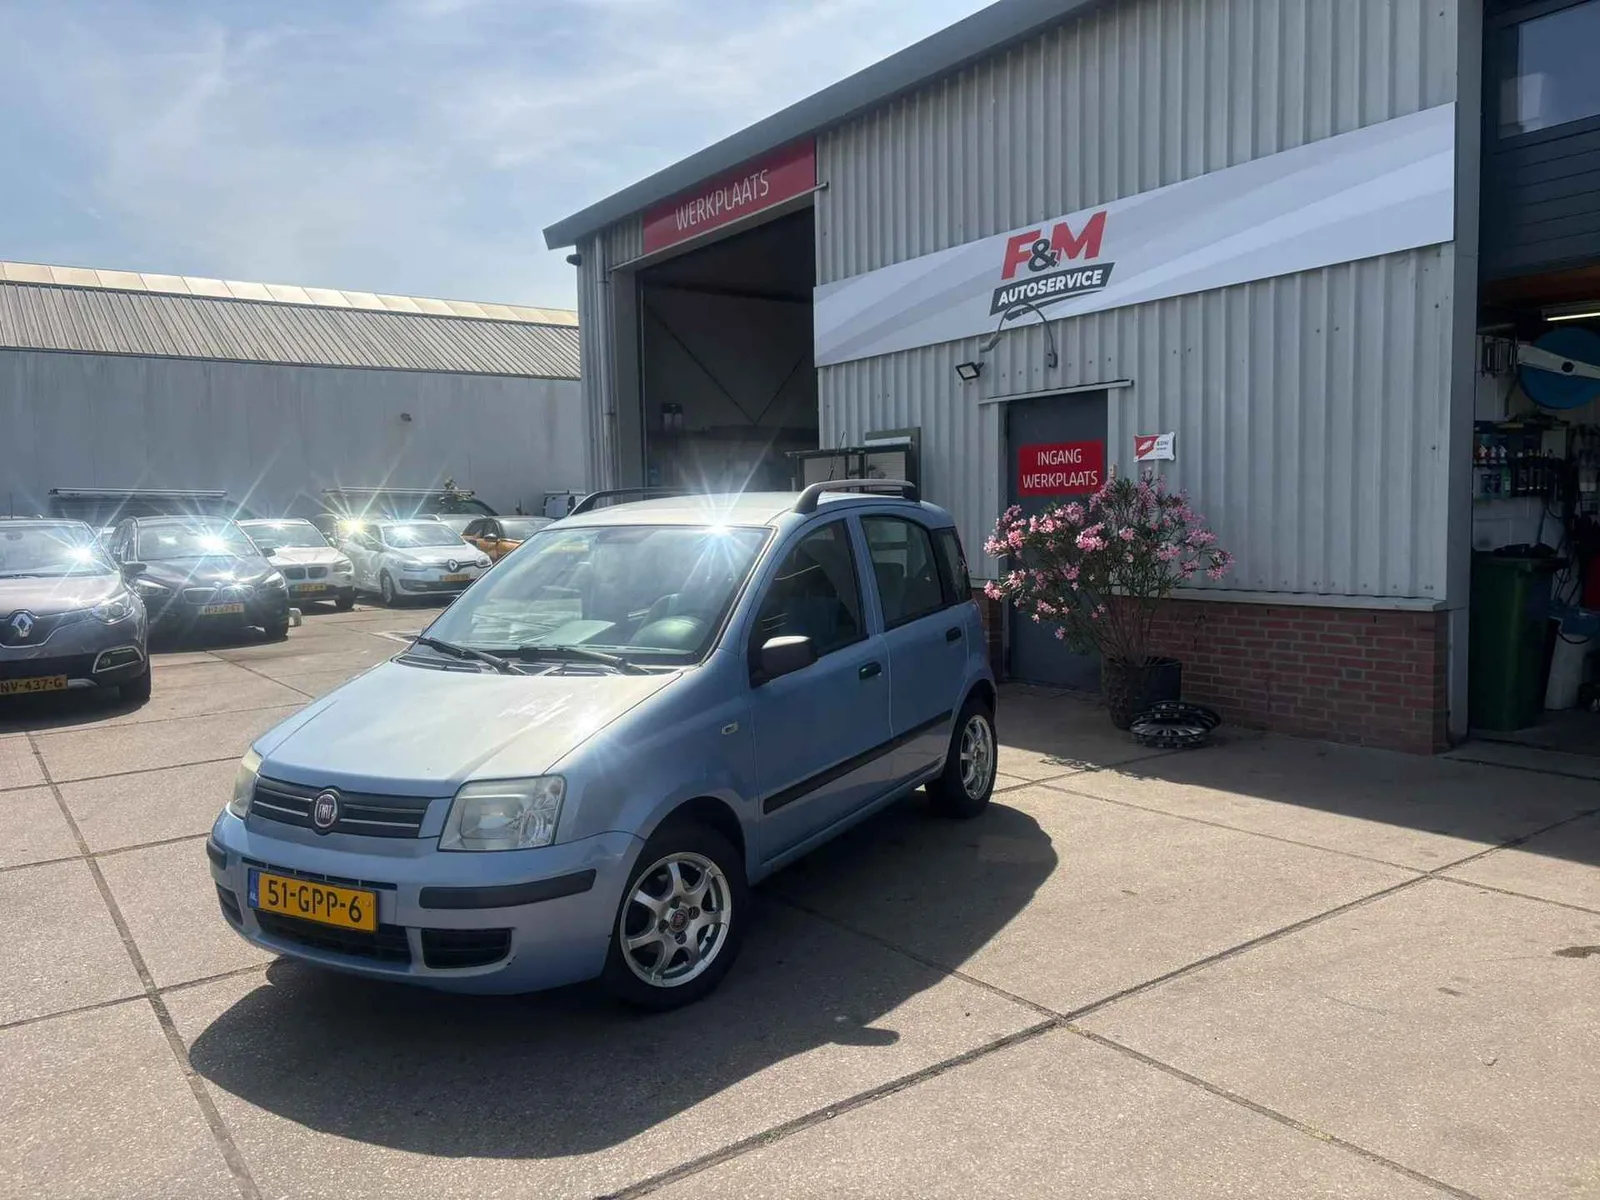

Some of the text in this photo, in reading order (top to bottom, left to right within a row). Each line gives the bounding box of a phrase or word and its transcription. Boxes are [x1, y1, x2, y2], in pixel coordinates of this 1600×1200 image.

[675, 169, 769, 231] WERKPLAATS
[1001, 210, 1107, 280] F&M
[998, 269, 1103, 306] AUTOSERVICE
[1037, 448, 1082, 466] INGANG
[1022, 470, 1098, 488] WERKPLAATS
[268, 880, 362, 923] 51-GPP-6
